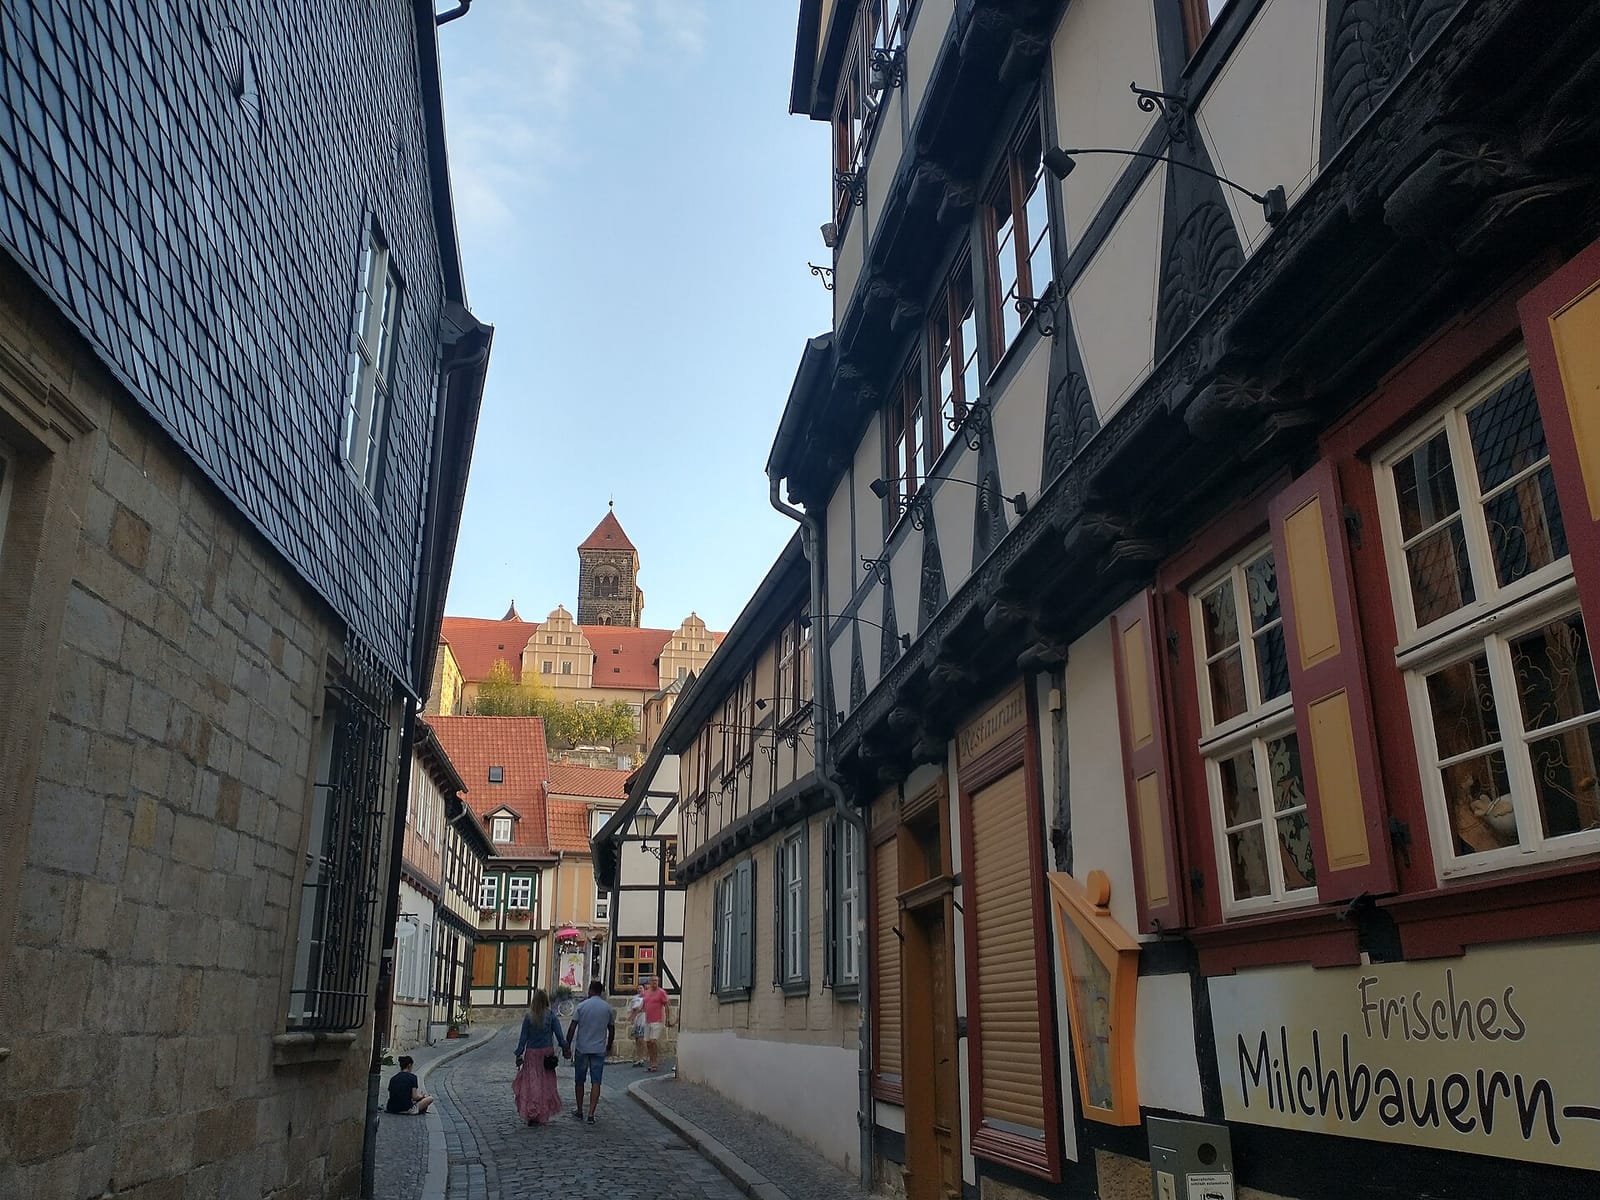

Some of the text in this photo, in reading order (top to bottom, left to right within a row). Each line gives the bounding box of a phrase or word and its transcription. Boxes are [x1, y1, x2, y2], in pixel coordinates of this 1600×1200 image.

[960, 692, 1024, 757] Restaurant
[1358, 968, 1527, 1042] Frisches
[1238, 1026, 1600, 1145] Milchbauern-
